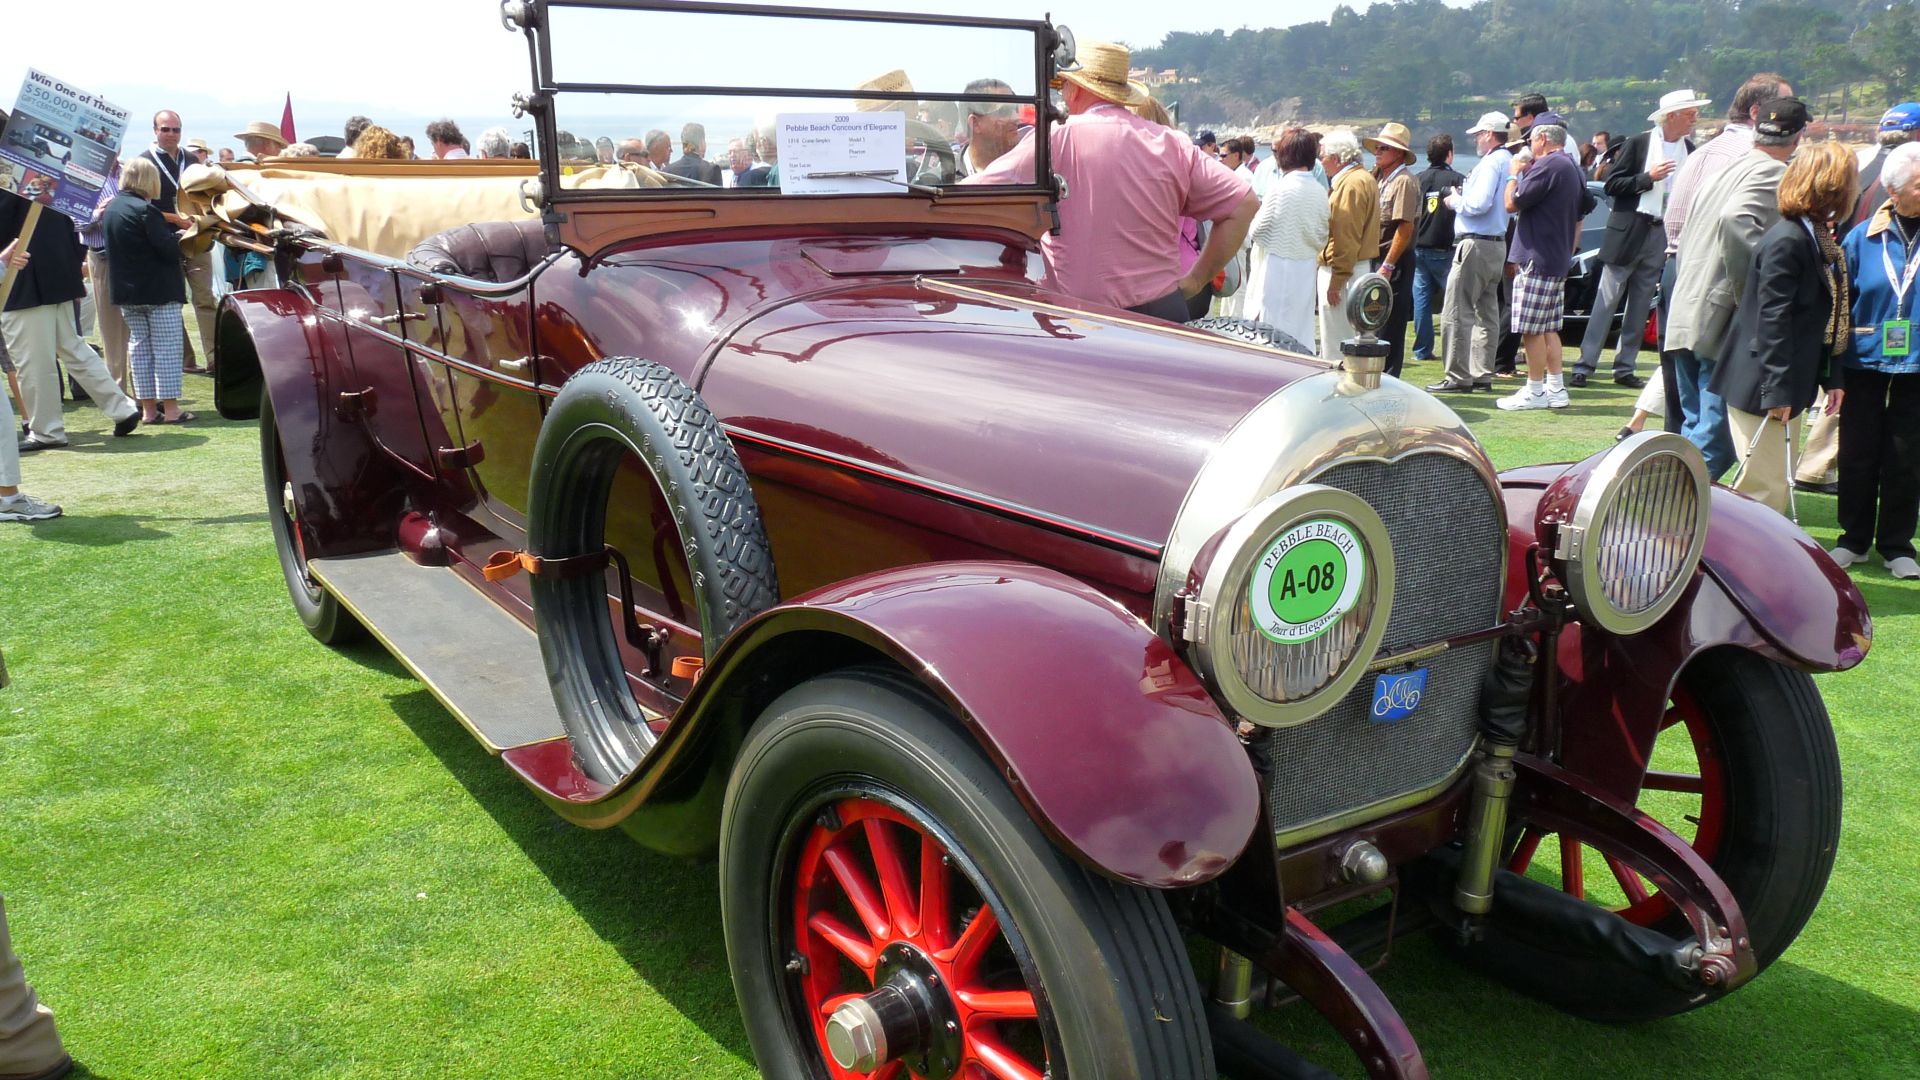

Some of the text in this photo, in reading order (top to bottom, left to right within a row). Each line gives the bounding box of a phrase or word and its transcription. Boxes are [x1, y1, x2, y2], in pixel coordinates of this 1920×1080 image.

[30, 71, 52, 87] Win
[55, 83, 77, 98] One
[79, 95, 91, 104] of
[93, 99, 127, 120] These!
[785, 123, 897, 132] Pebble Beach Concours d'Elegance
[834, 115, 850, 123] 2009
[1263, 523, 1355, 570] PEBBLE BEACH
[1280, 561, 1335, 601] A-08
[1270, 620, 1288, 635] Tour
